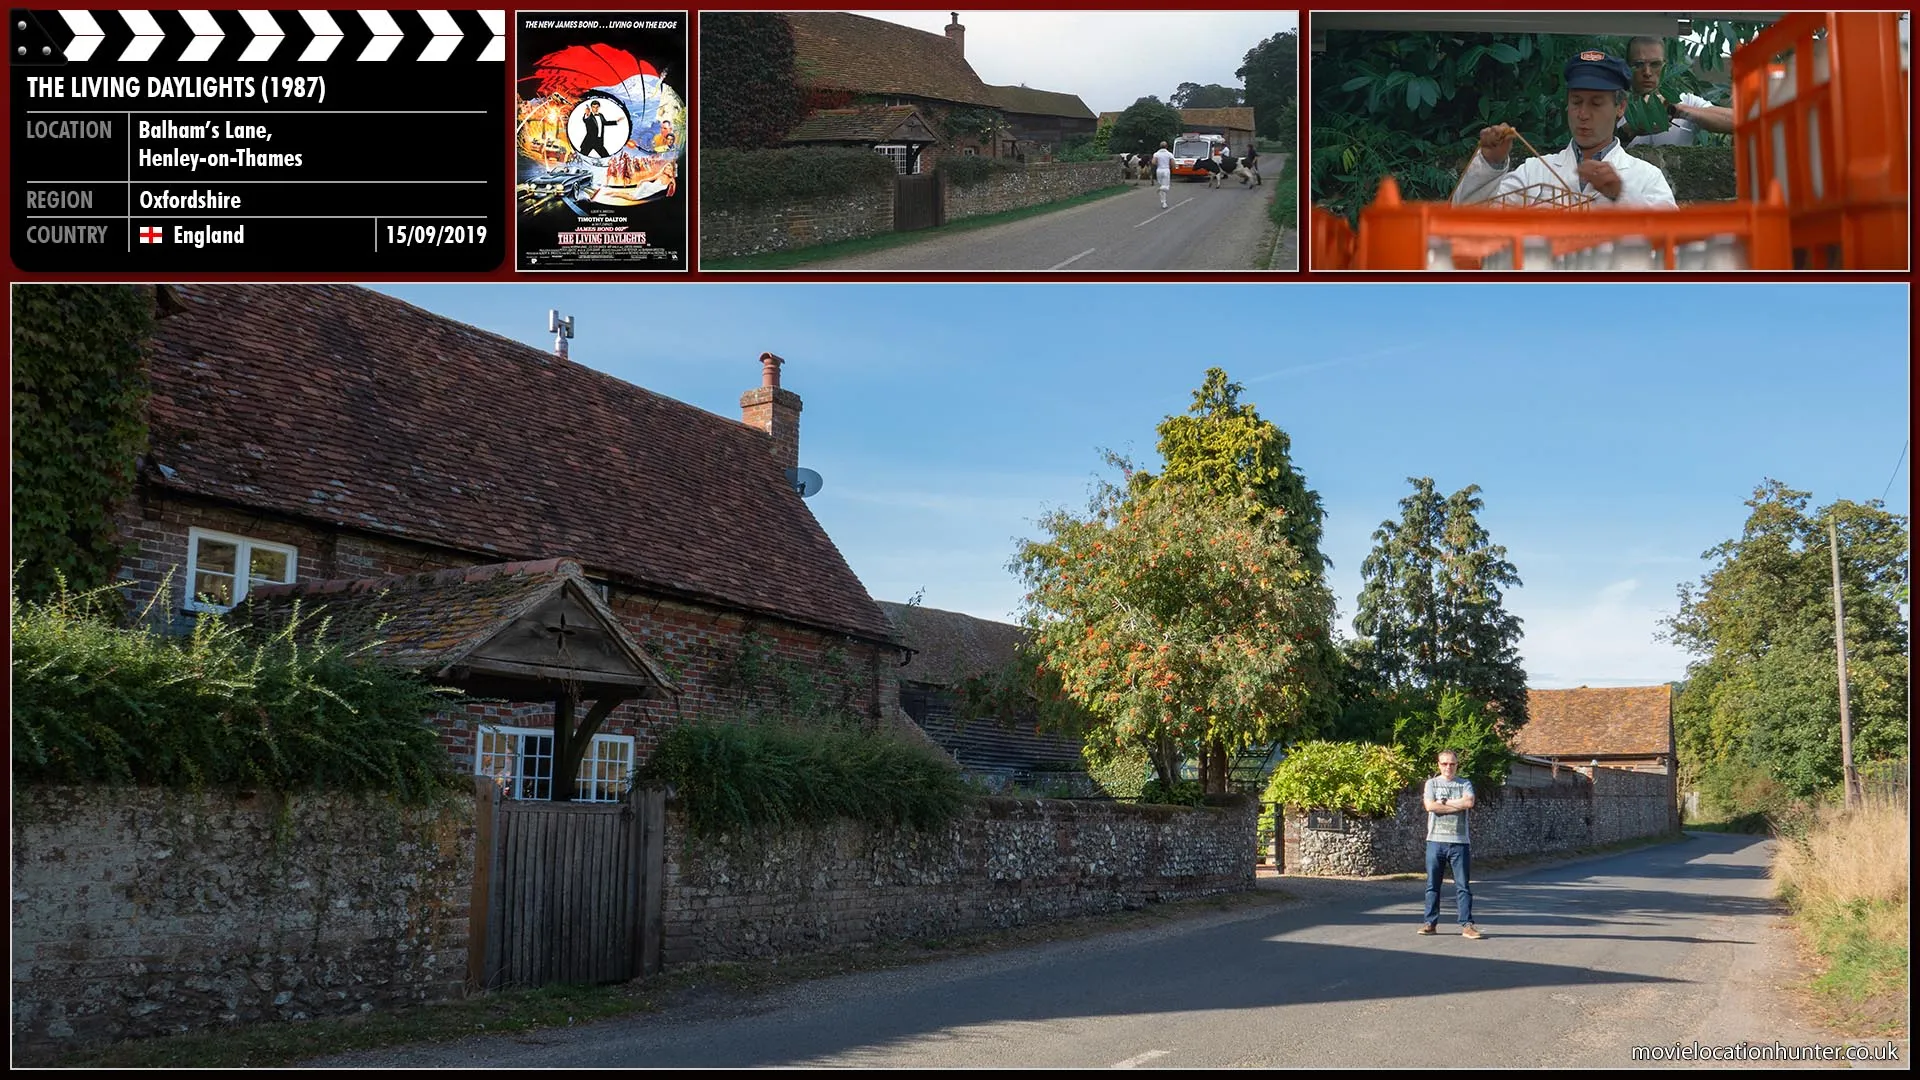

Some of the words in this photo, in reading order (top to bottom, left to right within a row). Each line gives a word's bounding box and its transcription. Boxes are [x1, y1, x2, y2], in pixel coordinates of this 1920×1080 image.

[525, 21, 538, 29] THE
[538, 21, 555, 29] NEW
[555, 21, 578, 29] JAMES
[578, 21, 599, 29] BOND
[609, 21, 633, 29] LIVING
[633, 21, 645, 29] ON
[645, 21, 658, 29] THE
[658, 21, 678, 29] EDGE
[557, 232, 574, 245] THE
[575, 232, 603, 245] LIVING
[603, 232, 646, 245] DAYLIGHTS
